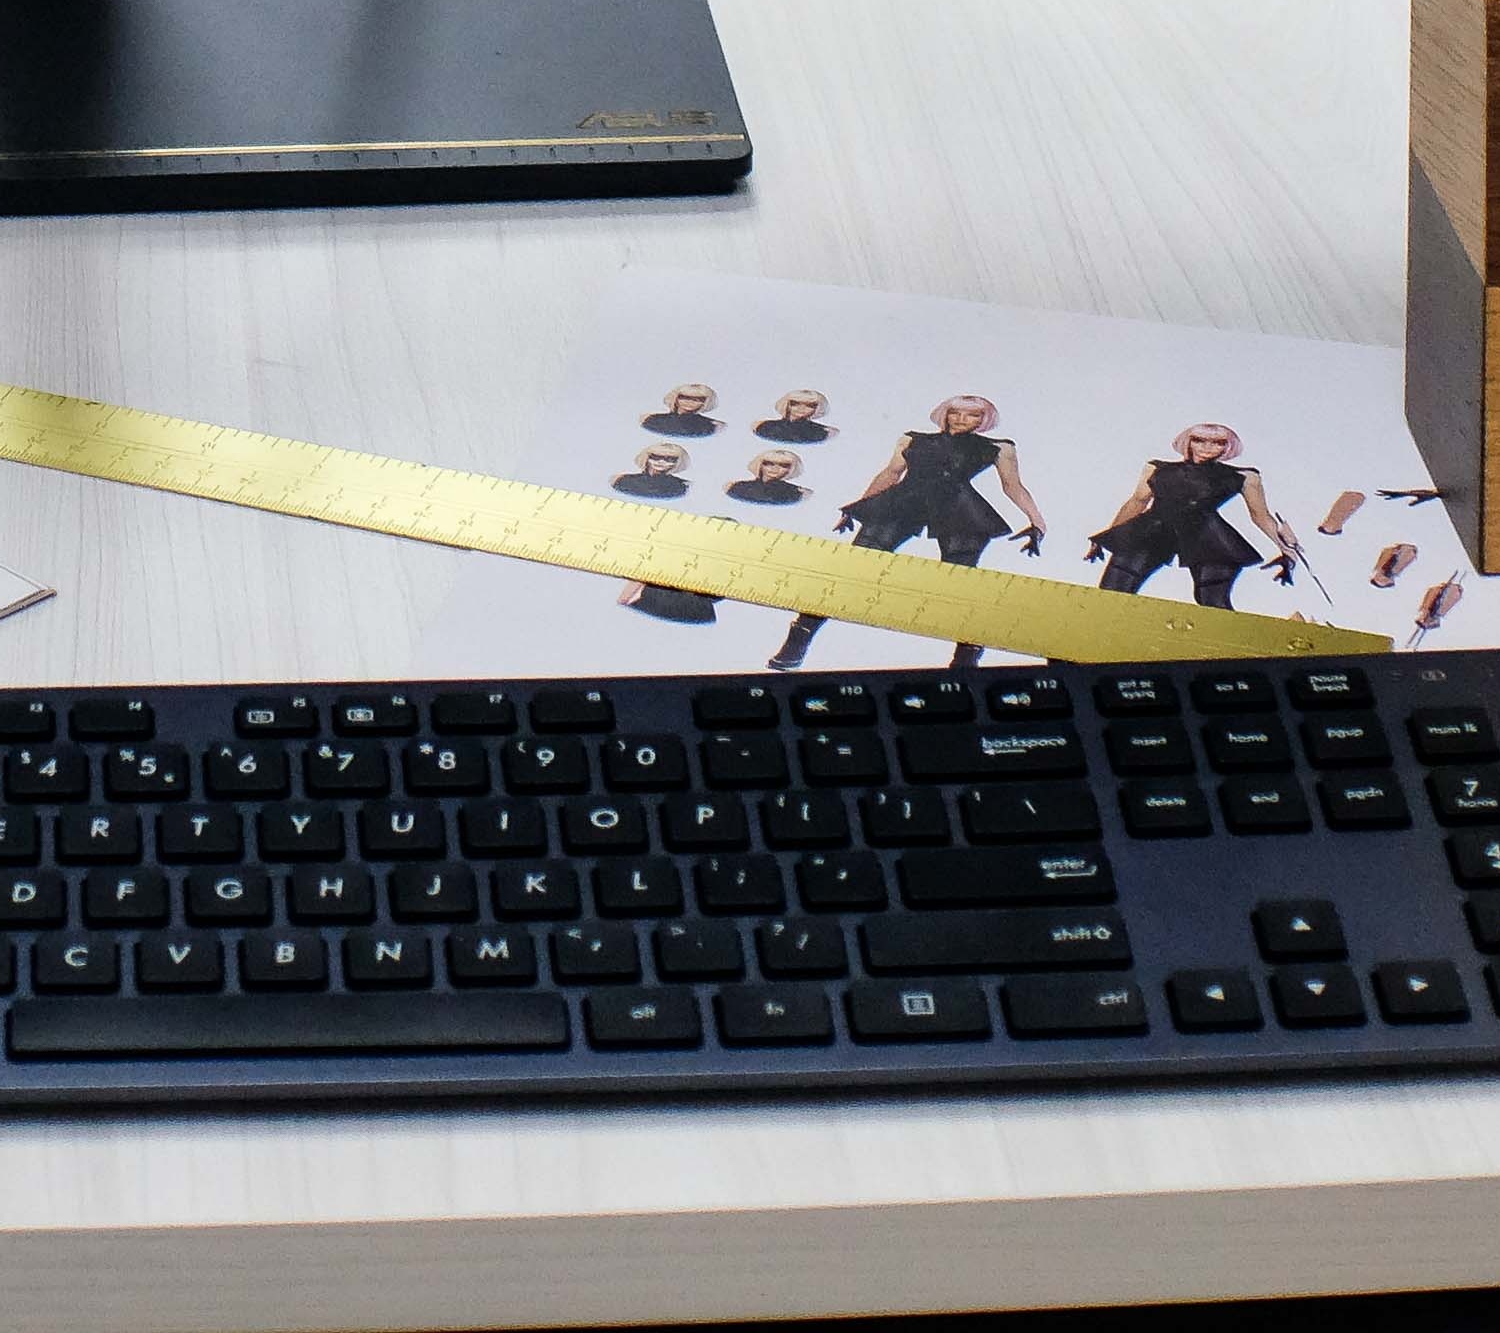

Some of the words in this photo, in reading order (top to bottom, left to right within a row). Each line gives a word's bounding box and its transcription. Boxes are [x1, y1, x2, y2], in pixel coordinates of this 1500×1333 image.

[982, 737, 1066, 751] backspace
[1228, 733, 1268, 742] home
[39, 759, 56, 776] 4
[139, 758, 156, 775] 5
[238, 755, 256, 773] 6
[338, 753, 354, 771] 7
[438, 751, 456, 770] 8
[537, 749, 554, 766] 9
[91, 818, 109, 837] R
[192, 817, 208, 836] T
[291, 816, 310, 834] Y
[392, 815, 414, 832] U
[697, 806, 714, 824] P
[12, 883, 36, 902] D
[117, 881, 134, 900] F
[215, 879, 243, 899] G
[320, 878, 343, 897] H
[427, 875, 441, 895] J
[526, 875, 545, 892] K
[633, 872, 647, 890] L
[1041, 859, 1088, 873] enter
[65, 946, 88, 966] C
[168, 945, 191, 964] V
[276, 942, 294, 963] B
[376, 942, 402, 961] N
[479, 940, 508, 959] M
